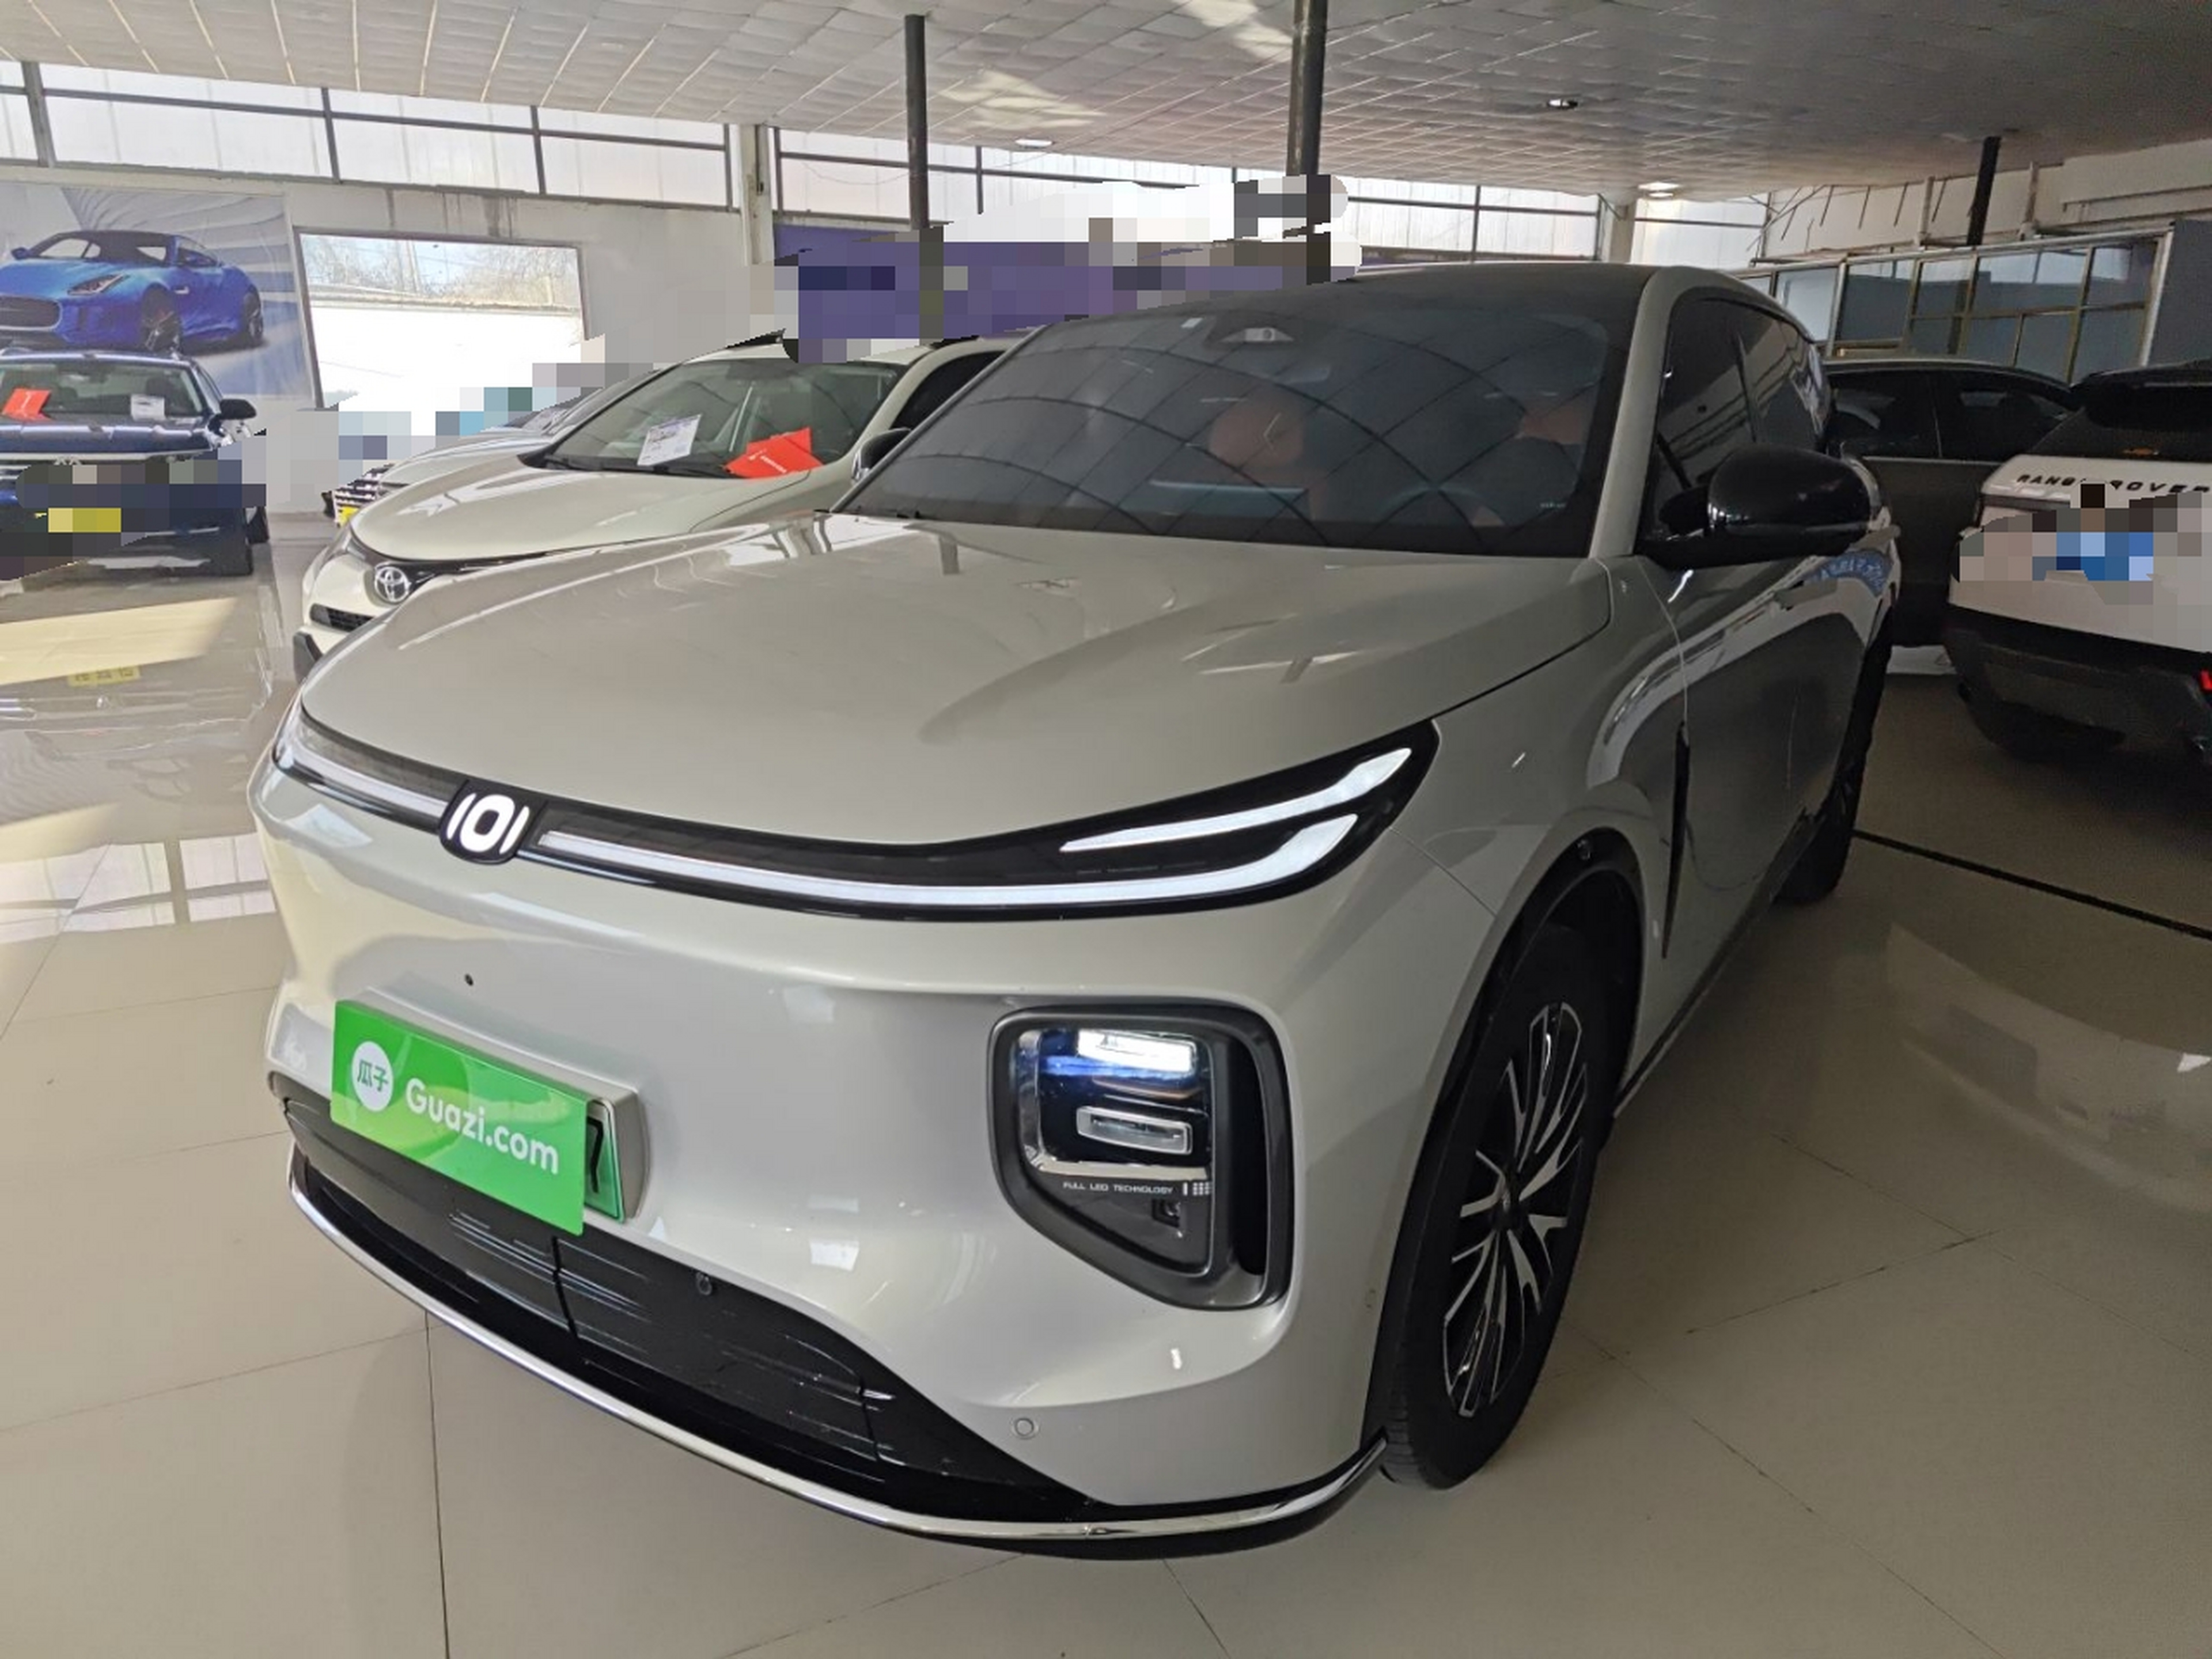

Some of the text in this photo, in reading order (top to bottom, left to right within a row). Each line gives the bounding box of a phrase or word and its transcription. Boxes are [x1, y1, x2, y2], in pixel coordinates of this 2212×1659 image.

[2017, 474, 2086, 486] RANG
[357, 1059, 389, 1092] 瓜子
[406, 1077, 559, 1176] Guazi.com
[1063, 1181, 1173, 1194] FULL LED TECHNOLOGY
